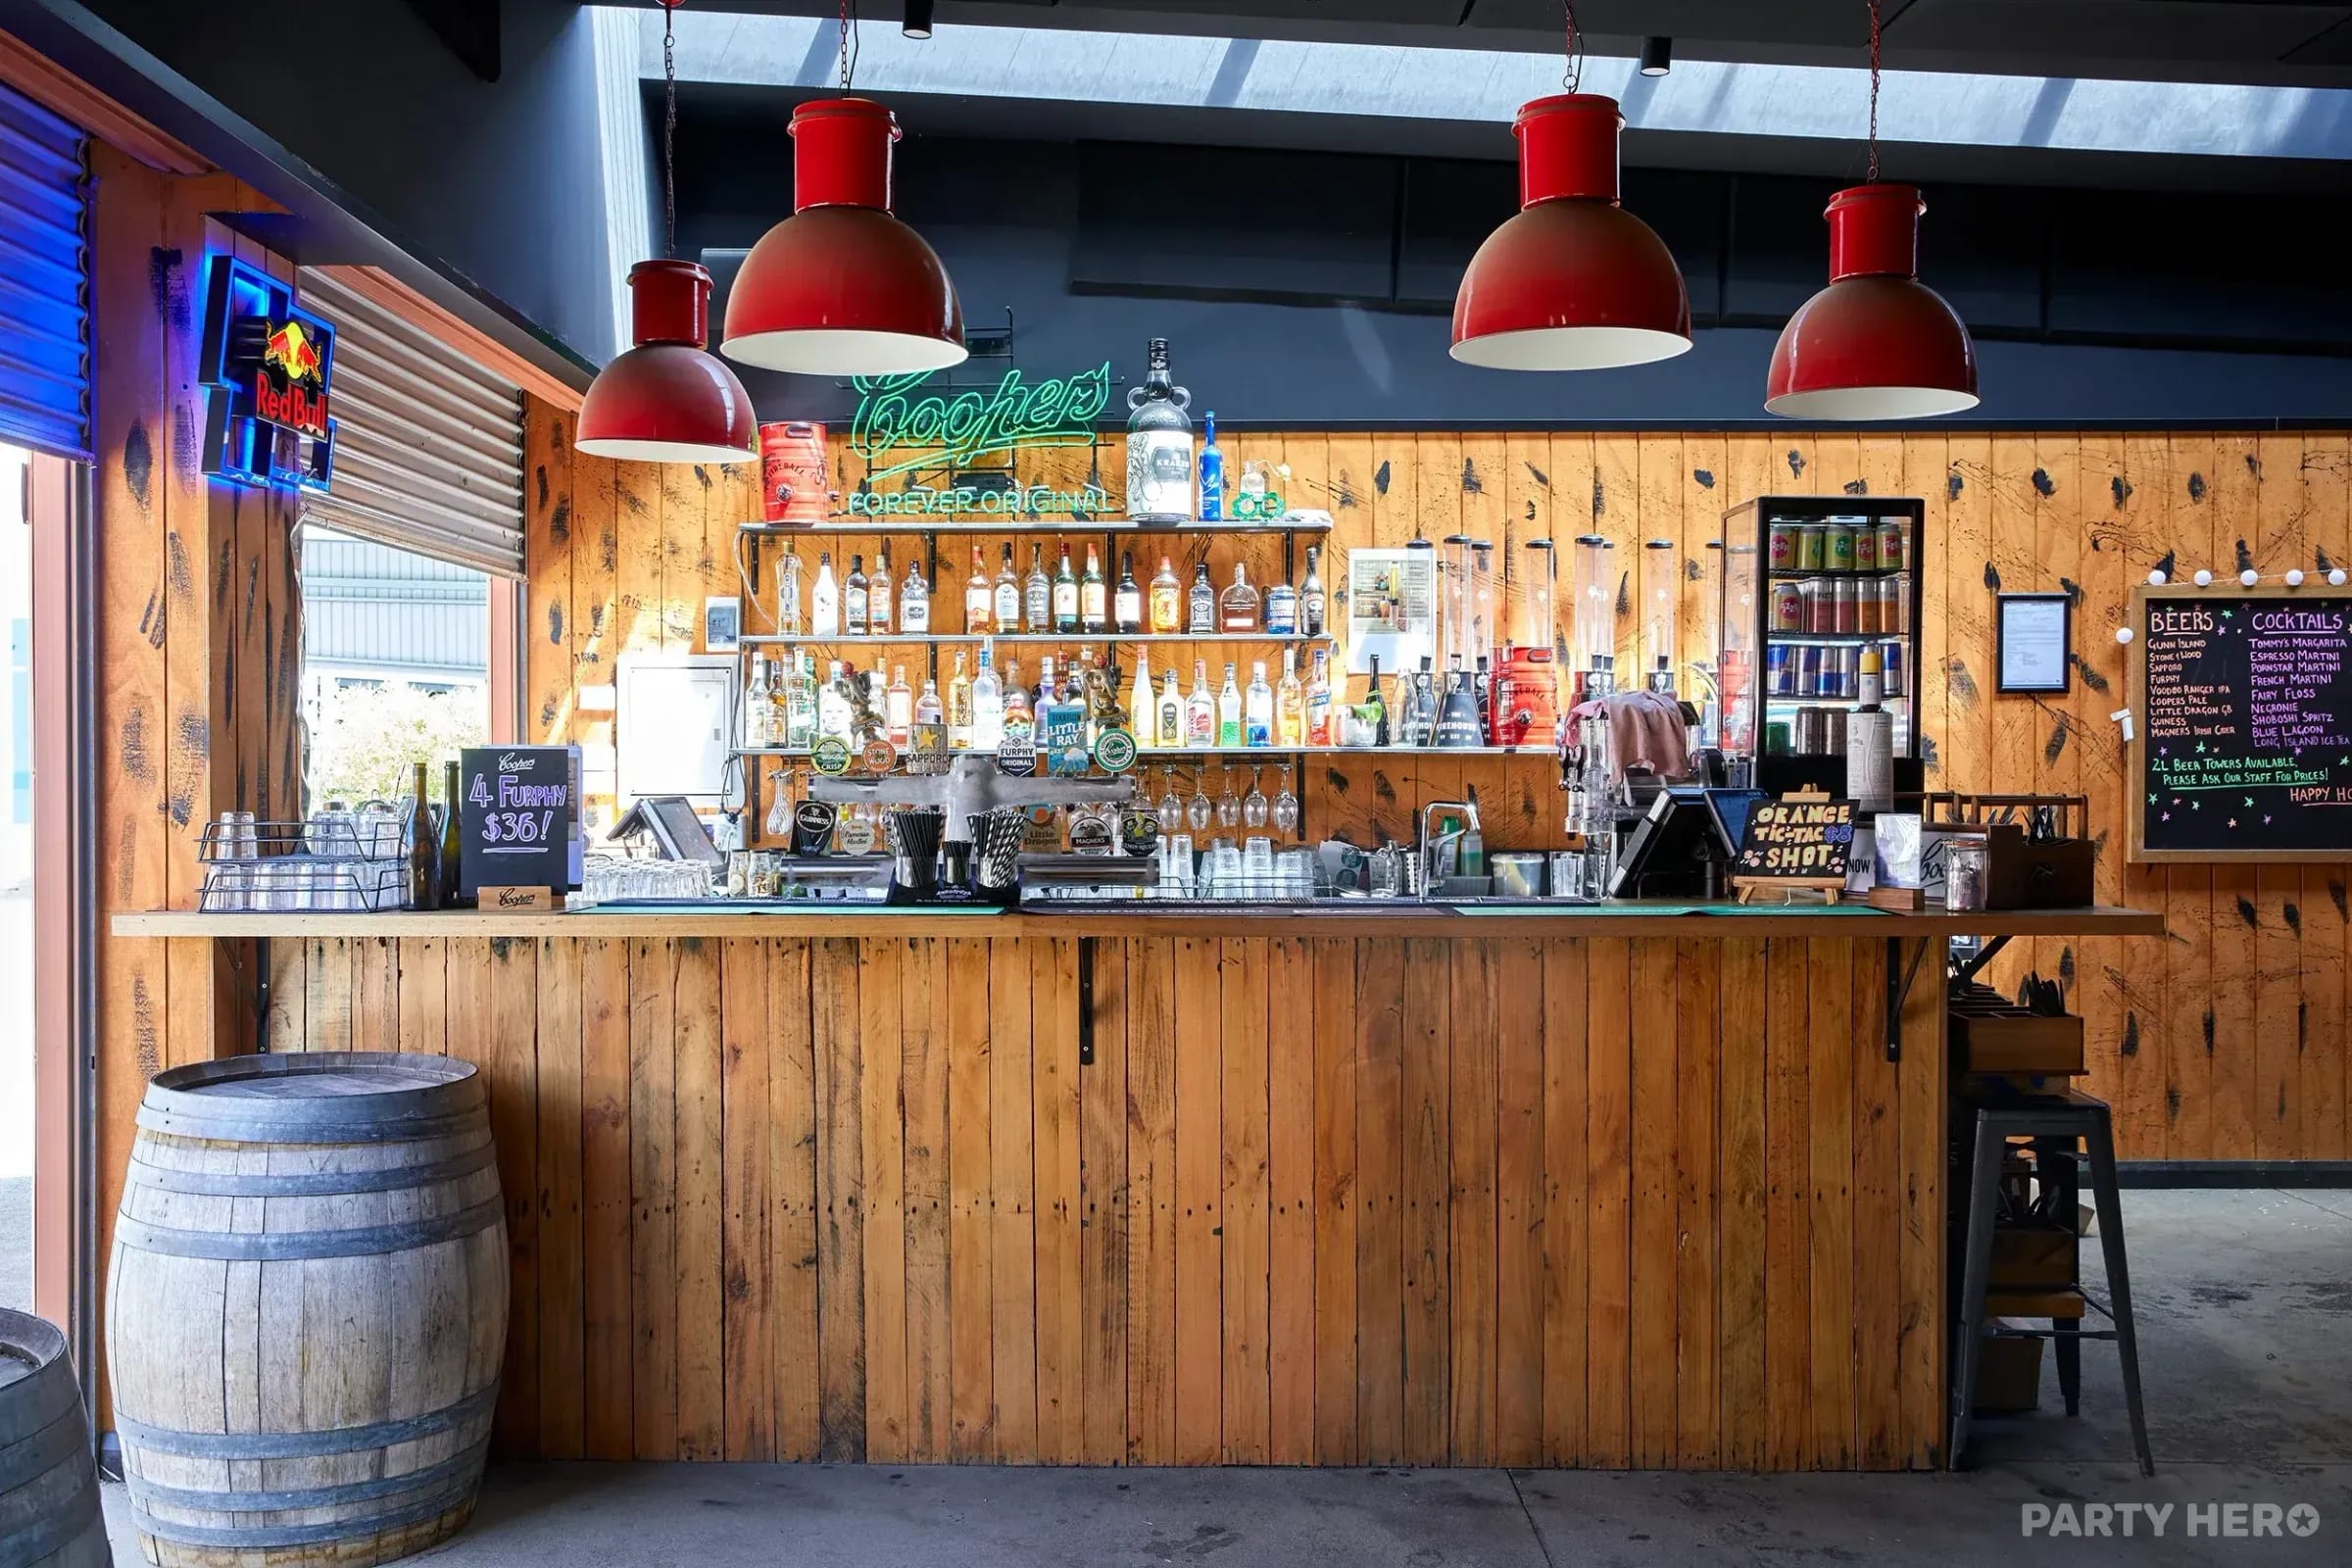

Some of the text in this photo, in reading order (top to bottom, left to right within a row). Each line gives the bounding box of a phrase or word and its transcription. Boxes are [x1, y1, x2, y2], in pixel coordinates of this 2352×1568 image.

[256, 370, 327, 436] Red Bull
[852, 362, 1109, 474] Coopers
[849, 488, 1114, 516] FOREVER ORIGINAL
[2150, 612, 2214, 632] BEERS
[2252, 612, 2343, 630] COCKTAILS
[2147, 638, 2207, 651] GUNN ISLAND
[2247, 637, 2348, 649] TOMMY'S MARGARITA
[2149, 652, 2175, 662] STONE
[2180, 650, 2202, 660] WOOD
[2250, 650, 2340, 662] ESPRESSO MARTINI
[2149, 662, 2182, 673] SAPPORO
[2250, 662, 2341, 673] PORNSTAR MARTINI
[2150, 674, 2180, 685] FURPHY
[2250, 673, 2332, 686] FRENCH MARTINI
[2149, 685, 2182, 696] VOODOO
[2251, 687, 2317, 702] FAIRY FLOSS
[2150, 695, 2208, 706] COOPERS PALE
[2150, 708, 2182, 716] LITTLE
[2183, 706, 2219, 716] DRAGON
[2250, 702, 2299, 714] NEGRONIE
[2150, 716, 2187, 727] GUINESS
[2251, 711, 2335, 725] SHOBOSHI SPRITZ
[1049, 720, 1086, 736] LITTLE
[2151, 726, 2190, 737] MAGNERS
[2252, 725, 2324, 738] BLUE LAGOON
[1056, 734, 1079, 747] RAY
[2254, 734, 2351, 750] LONG ISLAND ICE TEA
[868, 748, 891, 757] STONE
[1000, 747, 1034, 756] FURPHY
[498, 752, 536, 773] Coopers
[906, 753, 949, 764] SAPPORO
[1001, 759, 1033, 767] ORIGINAL
[2151, 758, 2170, 771] 2L
[2173, 758, 2201, 772] BEER
[2202, 758, 2242, 770] TOWERS
[2163, 766, 2329, 785] PLEASE ASK OUR STAFF FOR PRICES!
[468, 772, 567, 808] 4 FURPHY
[2289, 786, 2330, 802] HAPPY
[1756, 805, 1851, 824] ORANGE
[481, 809, 555, 843] $36!
[1029, 830, 1054, 839] Little
[1824, 824, 1853, 844] $8
[1024, 838, 1060, 847] Dragon
[1765, 844, 1835, 869] SHOT
[498, 887, 536, 908] Coopers
